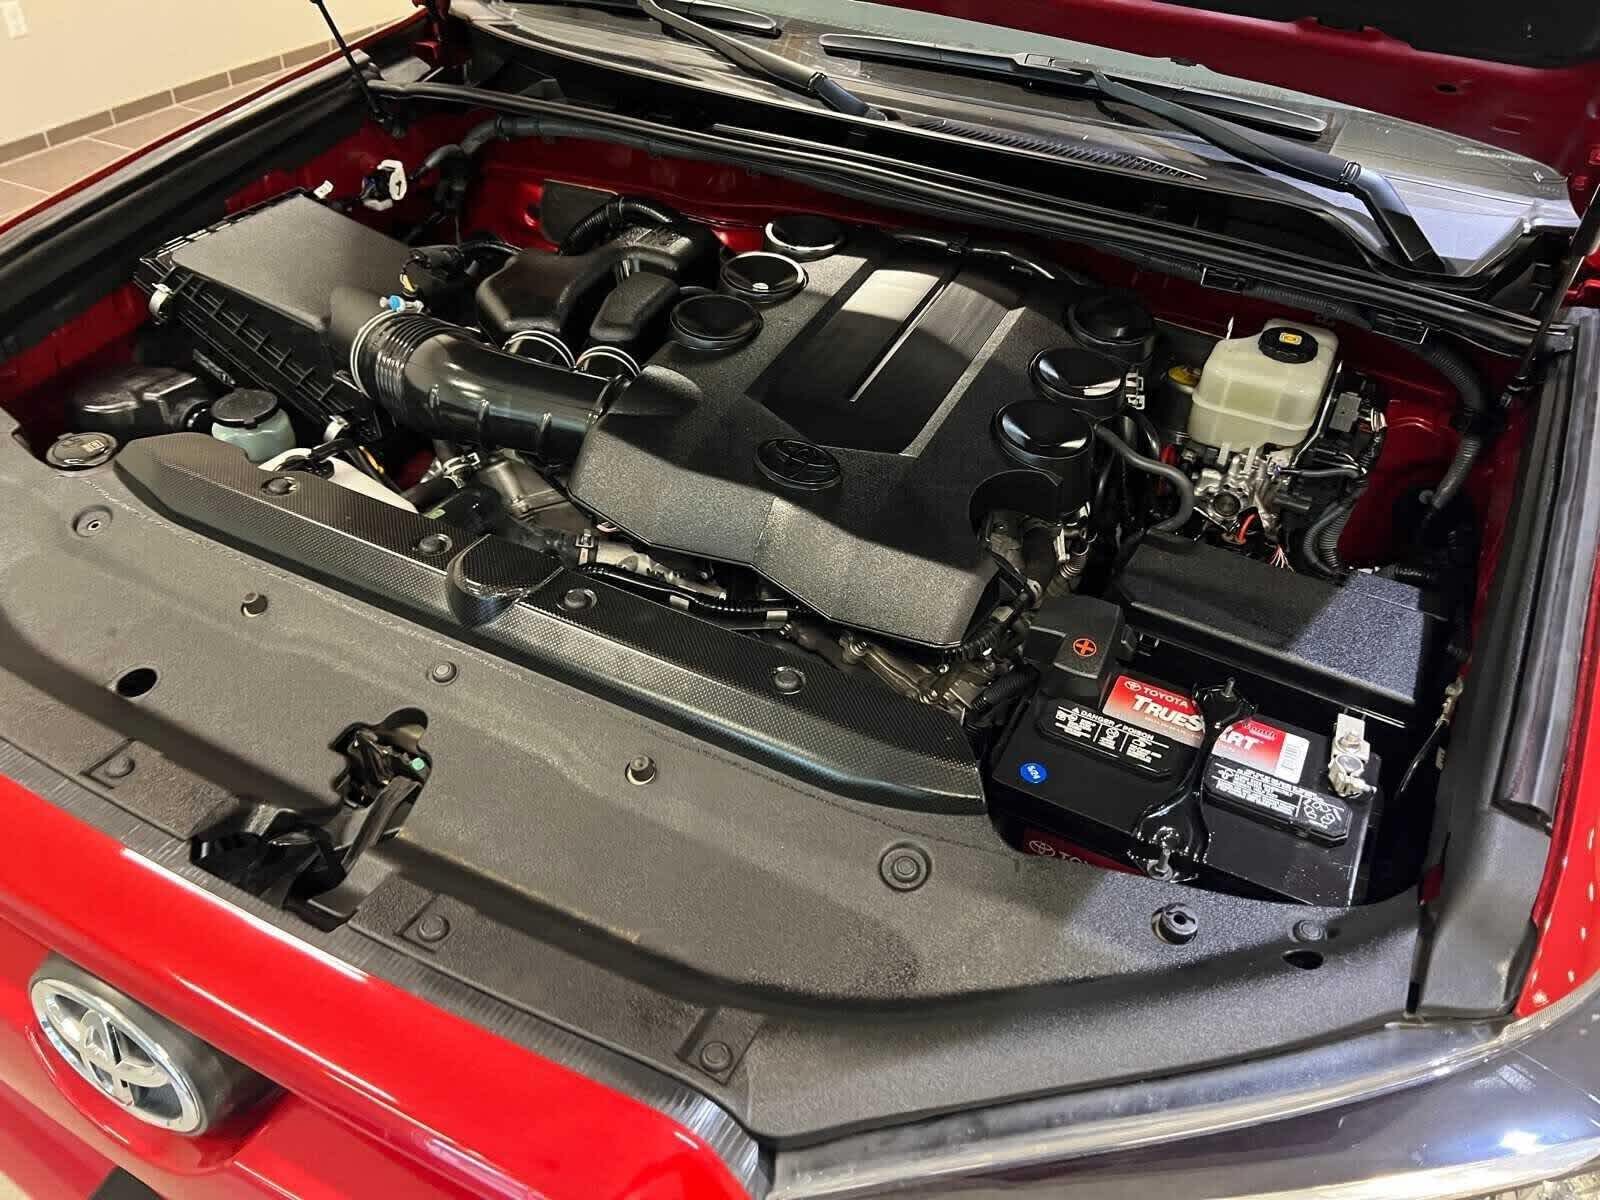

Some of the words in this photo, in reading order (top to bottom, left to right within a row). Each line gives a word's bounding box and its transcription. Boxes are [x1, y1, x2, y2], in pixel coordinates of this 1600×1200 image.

[1143, 687, 1189, 709] TOYOTA
[1080, 710, 1115, 727] DANGER
[1122, 724, 1155, 741] POISON
